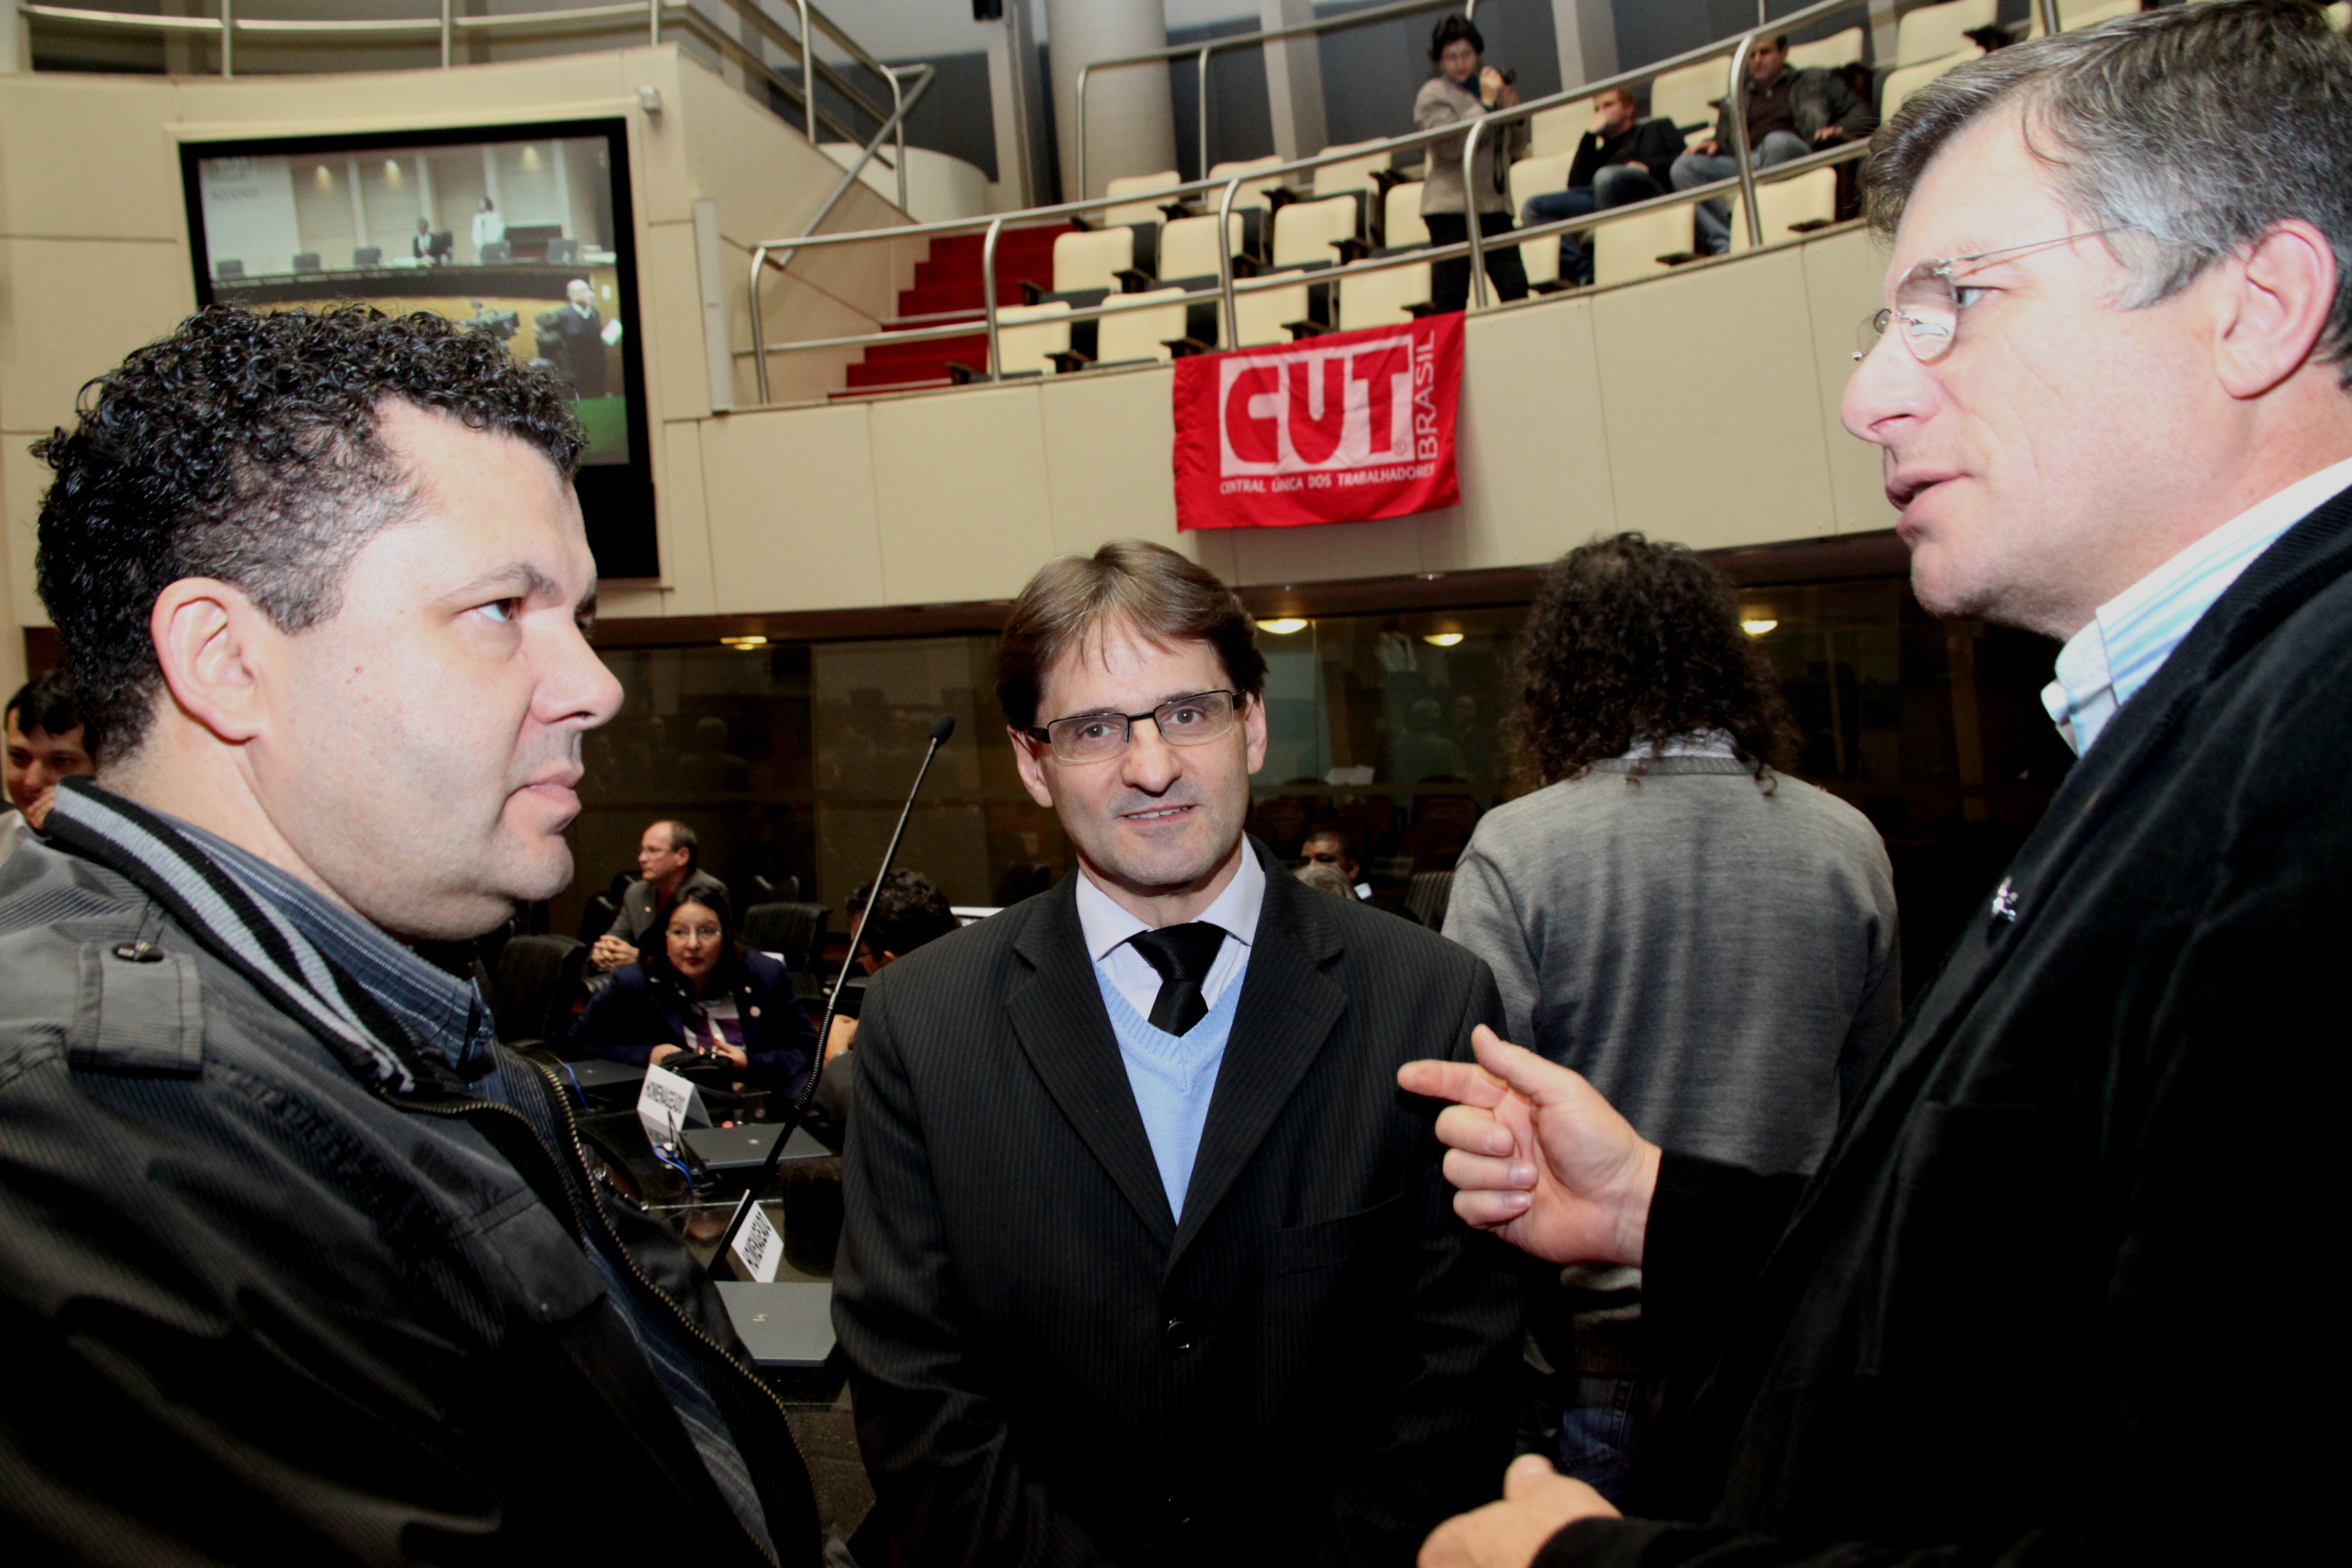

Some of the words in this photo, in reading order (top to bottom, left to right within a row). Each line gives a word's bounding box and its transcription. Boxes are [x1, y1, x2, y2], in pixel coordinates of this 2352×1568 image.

[1224, 344, 1410, 466] CUT
[1414, 329, 1439, 460] BRASIL
[1307, 472, 1332, 489] DOS
